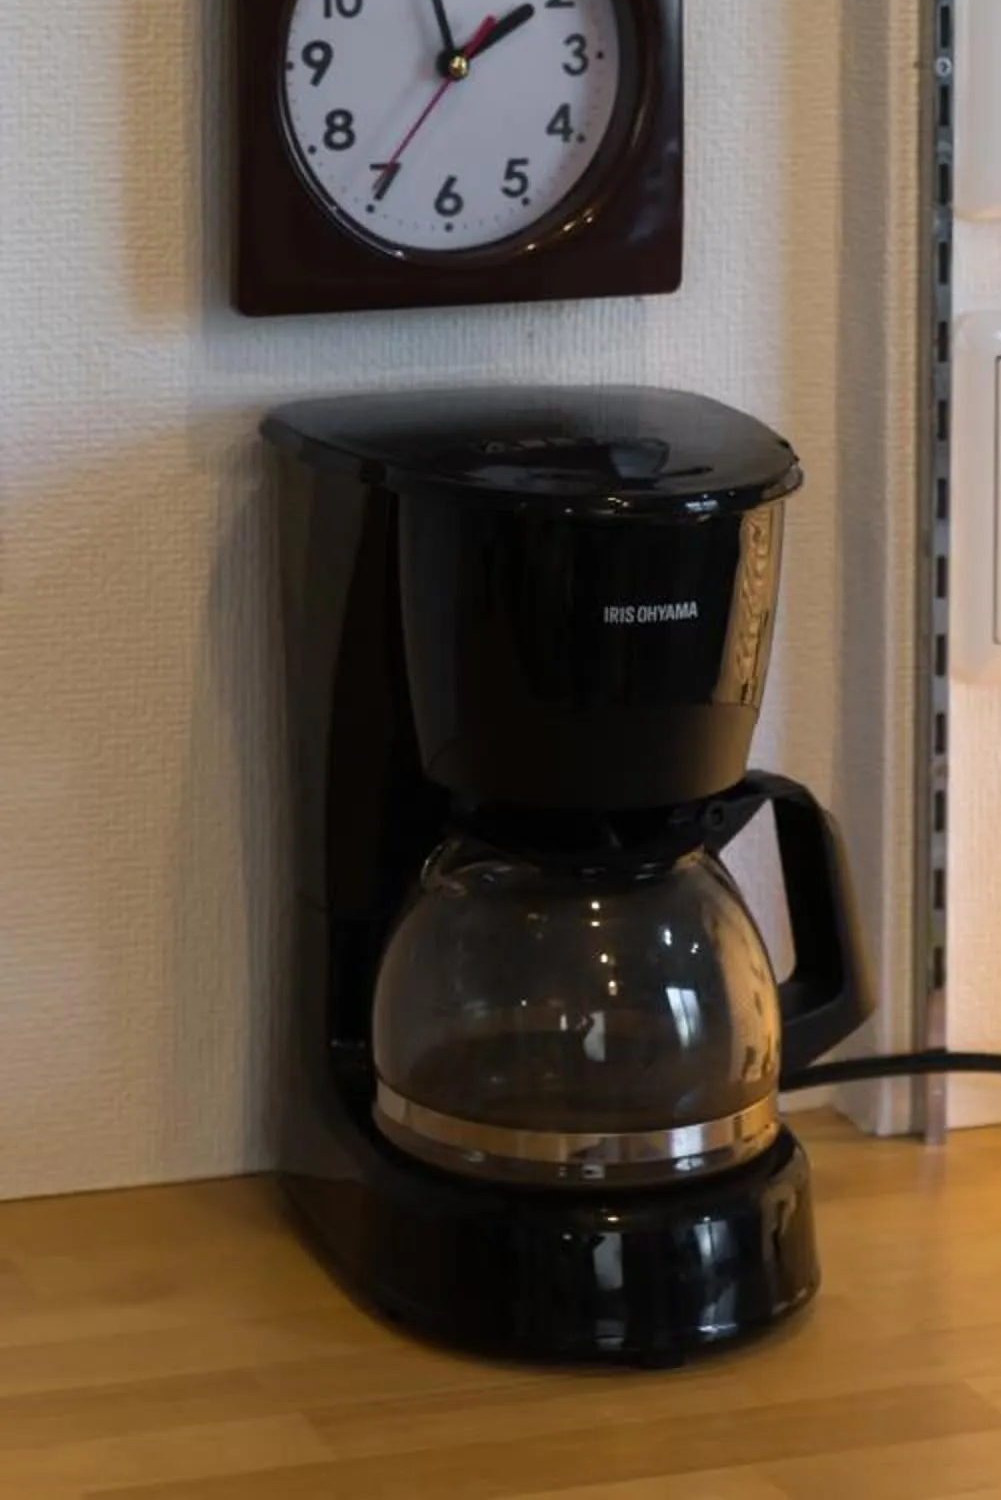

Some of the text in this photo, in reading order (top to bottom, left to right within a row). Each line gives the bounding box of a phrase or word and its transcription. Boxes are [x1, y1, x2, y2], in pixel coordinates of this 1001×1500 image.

[301, 40, 334, 87] 9
[562, 34, 589, 77] 3
[322, 109, 356, 151] 8
[546, 103, 574, 143] 4
[369, 162, 401, 201] 7
[434, 176, 464, 217] 6
[502, 158, 530, 199] 5
[603, 600, 699, 624] IRIS OHYAMA
